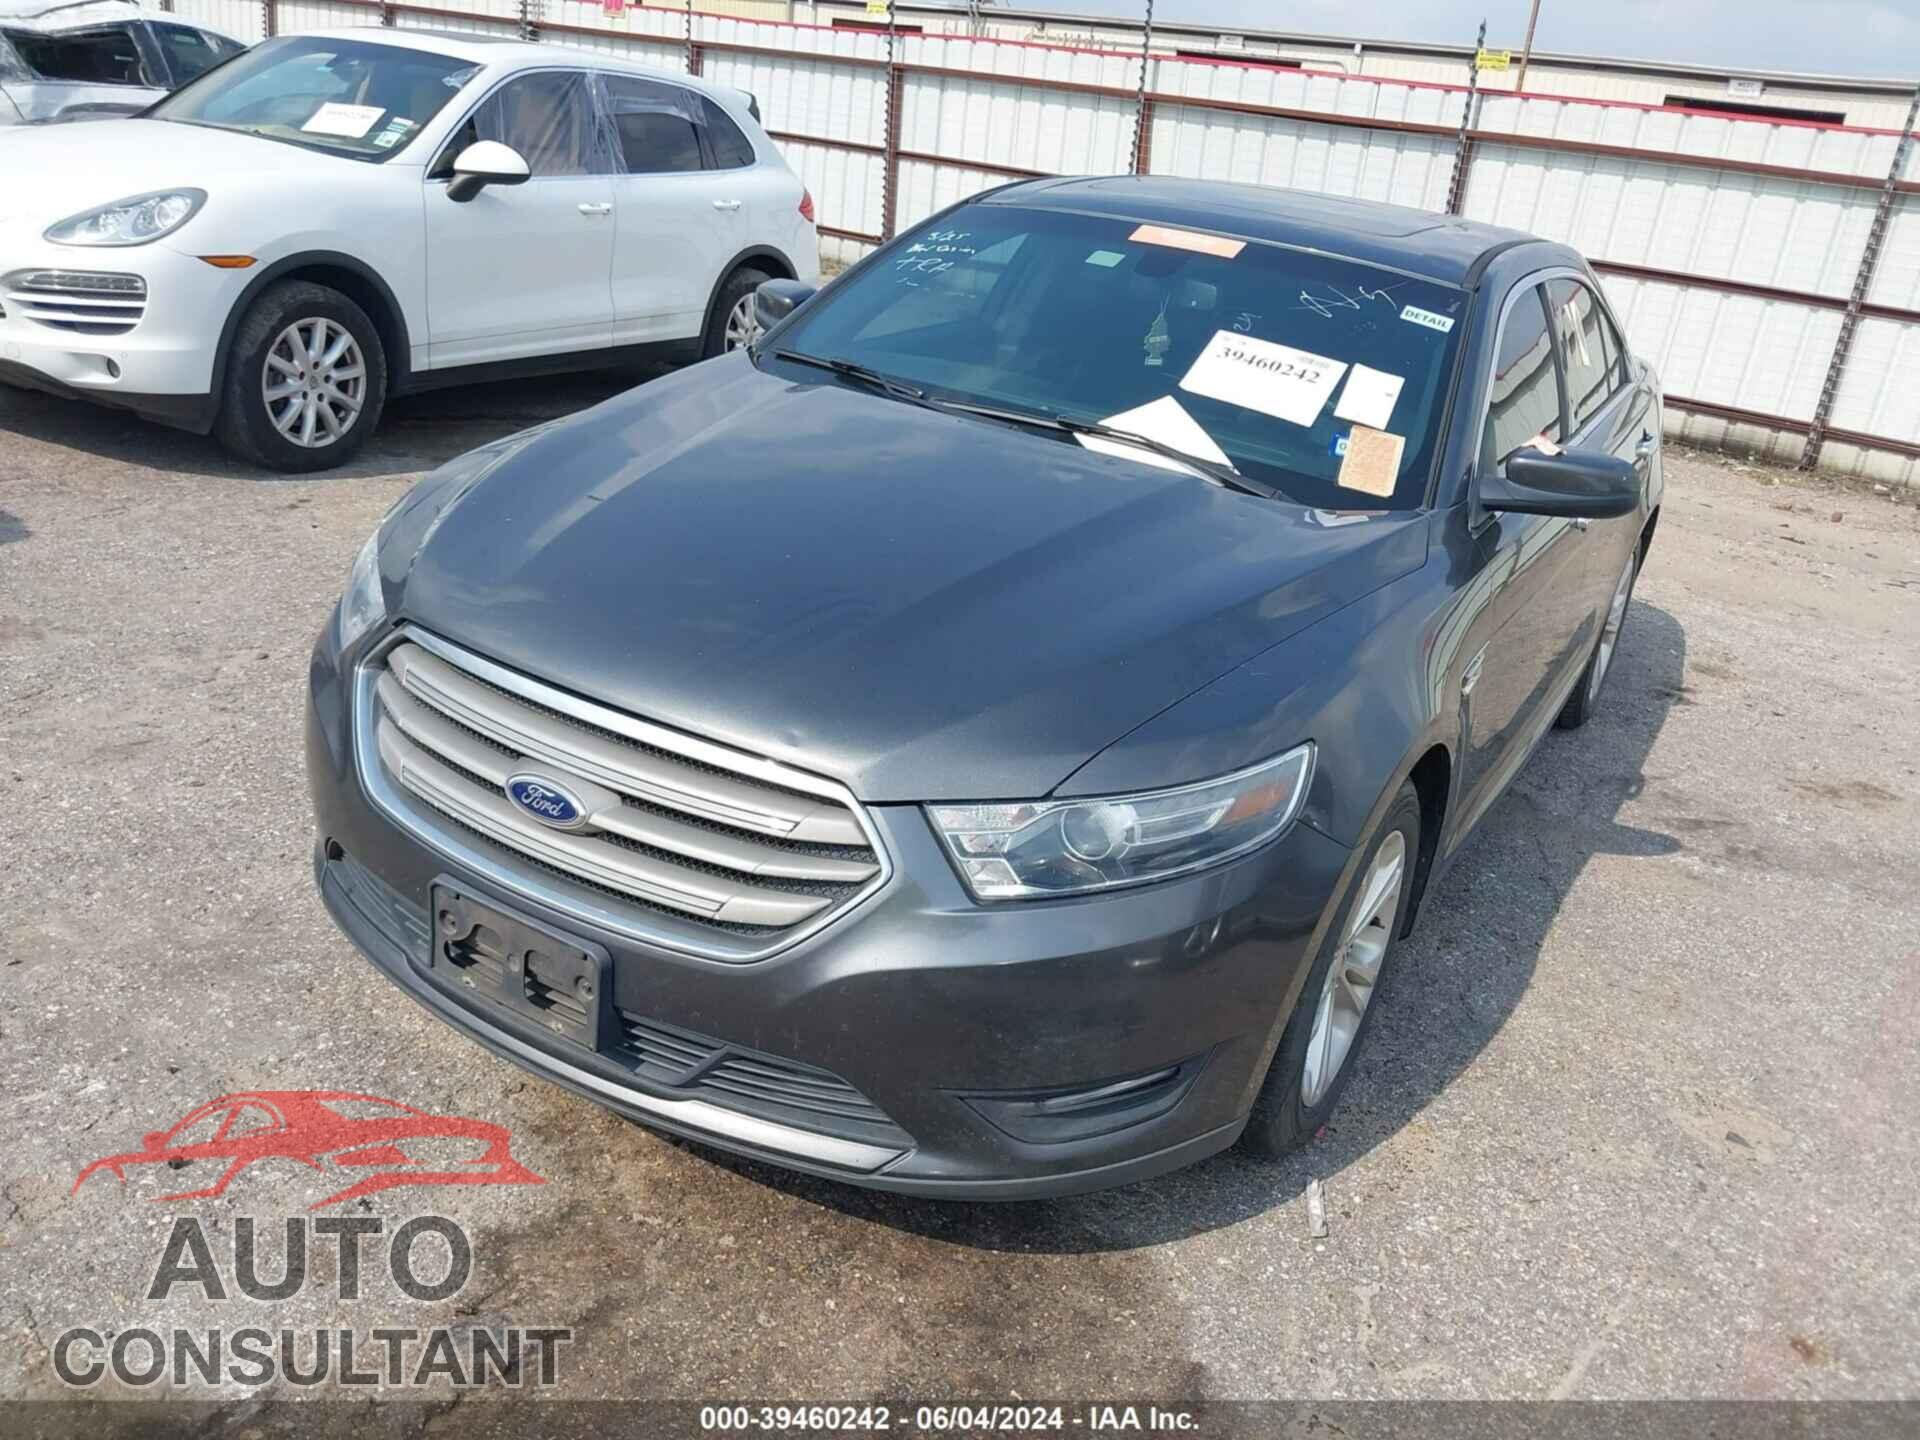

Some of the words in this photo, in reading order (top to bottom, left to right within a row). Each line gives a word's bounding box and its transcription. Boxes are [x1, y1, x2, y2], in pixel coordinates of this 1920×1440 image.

[1404, 310, 1449, 329] DETAIL
[1216, 346, 1321, 384] 39460242
[521, 784, 565, 816] Ford
